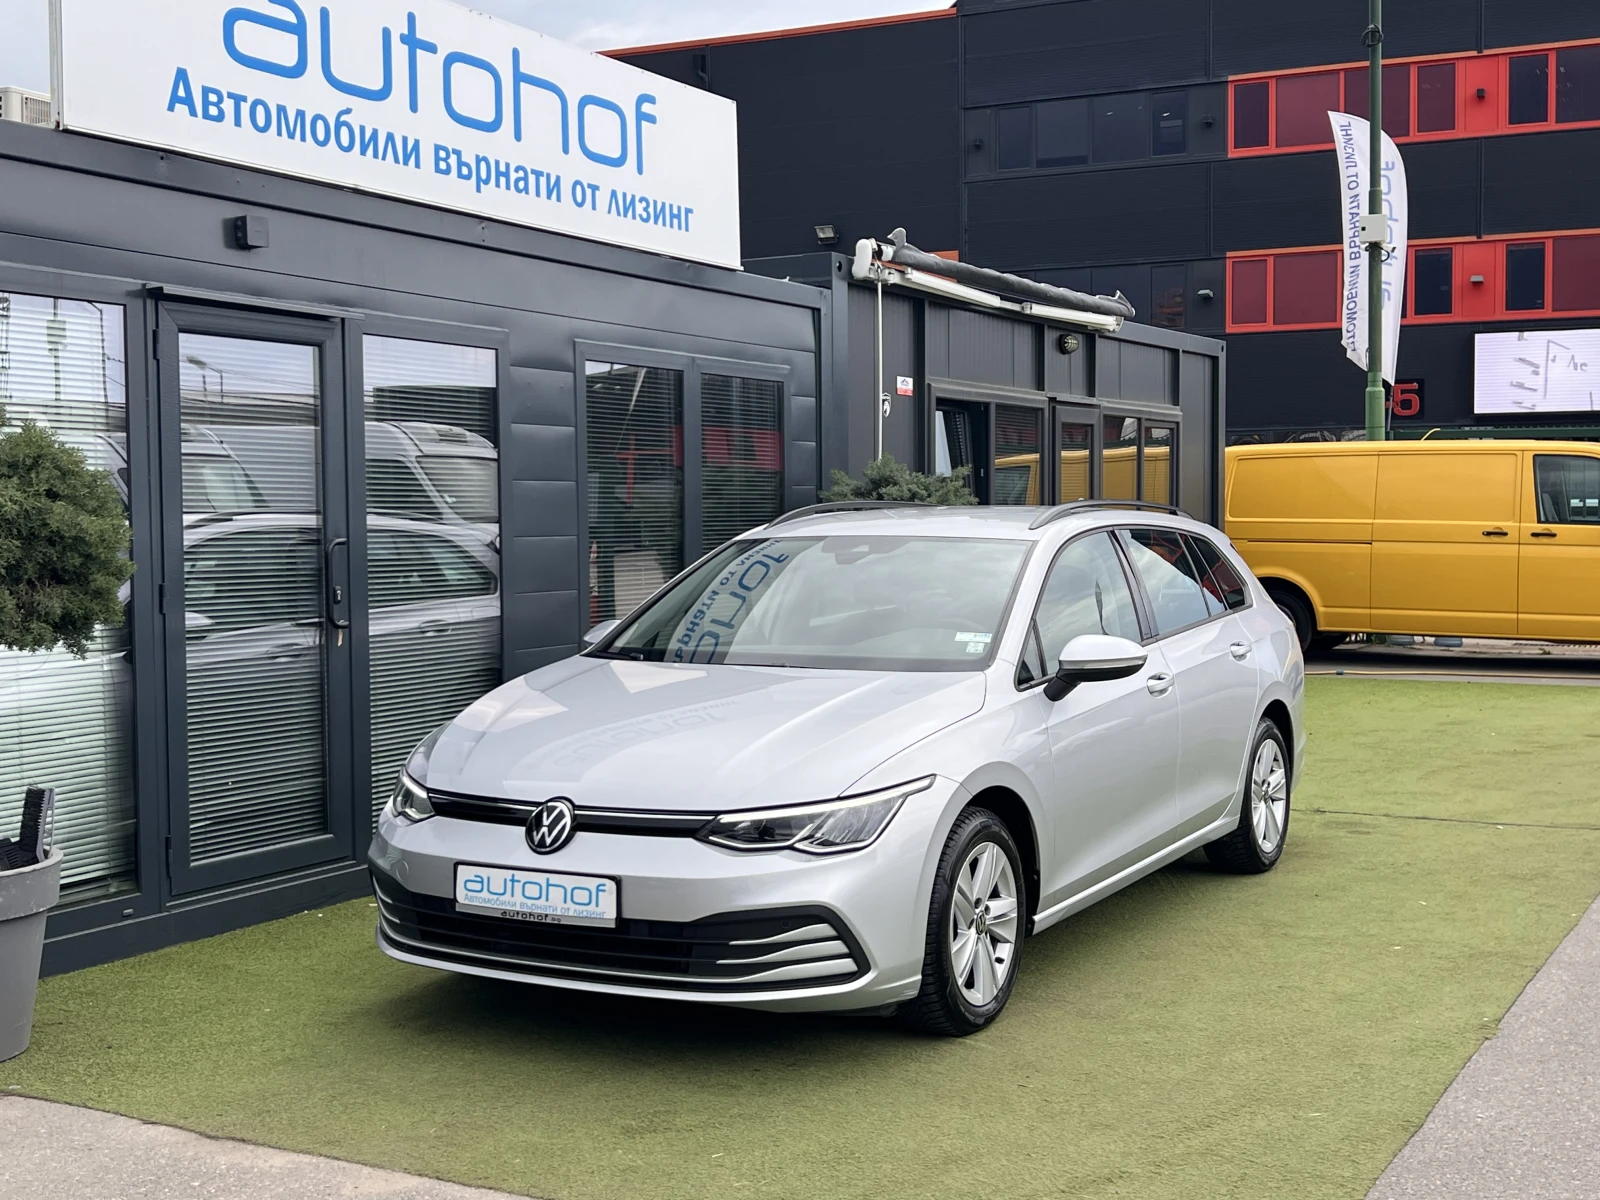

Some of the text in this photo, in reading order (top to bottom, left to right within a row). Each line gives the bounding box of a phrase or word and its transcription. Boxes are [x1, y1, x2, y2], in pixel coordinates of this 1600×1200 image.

[222, 0, 657, 175] autohof
[167, 67, 693, 232] Автомобили върнати от лизинг
[463, 873, 607, 908] autohof
[464, 893, 607, 919] Автомобили върнати от лизинг
